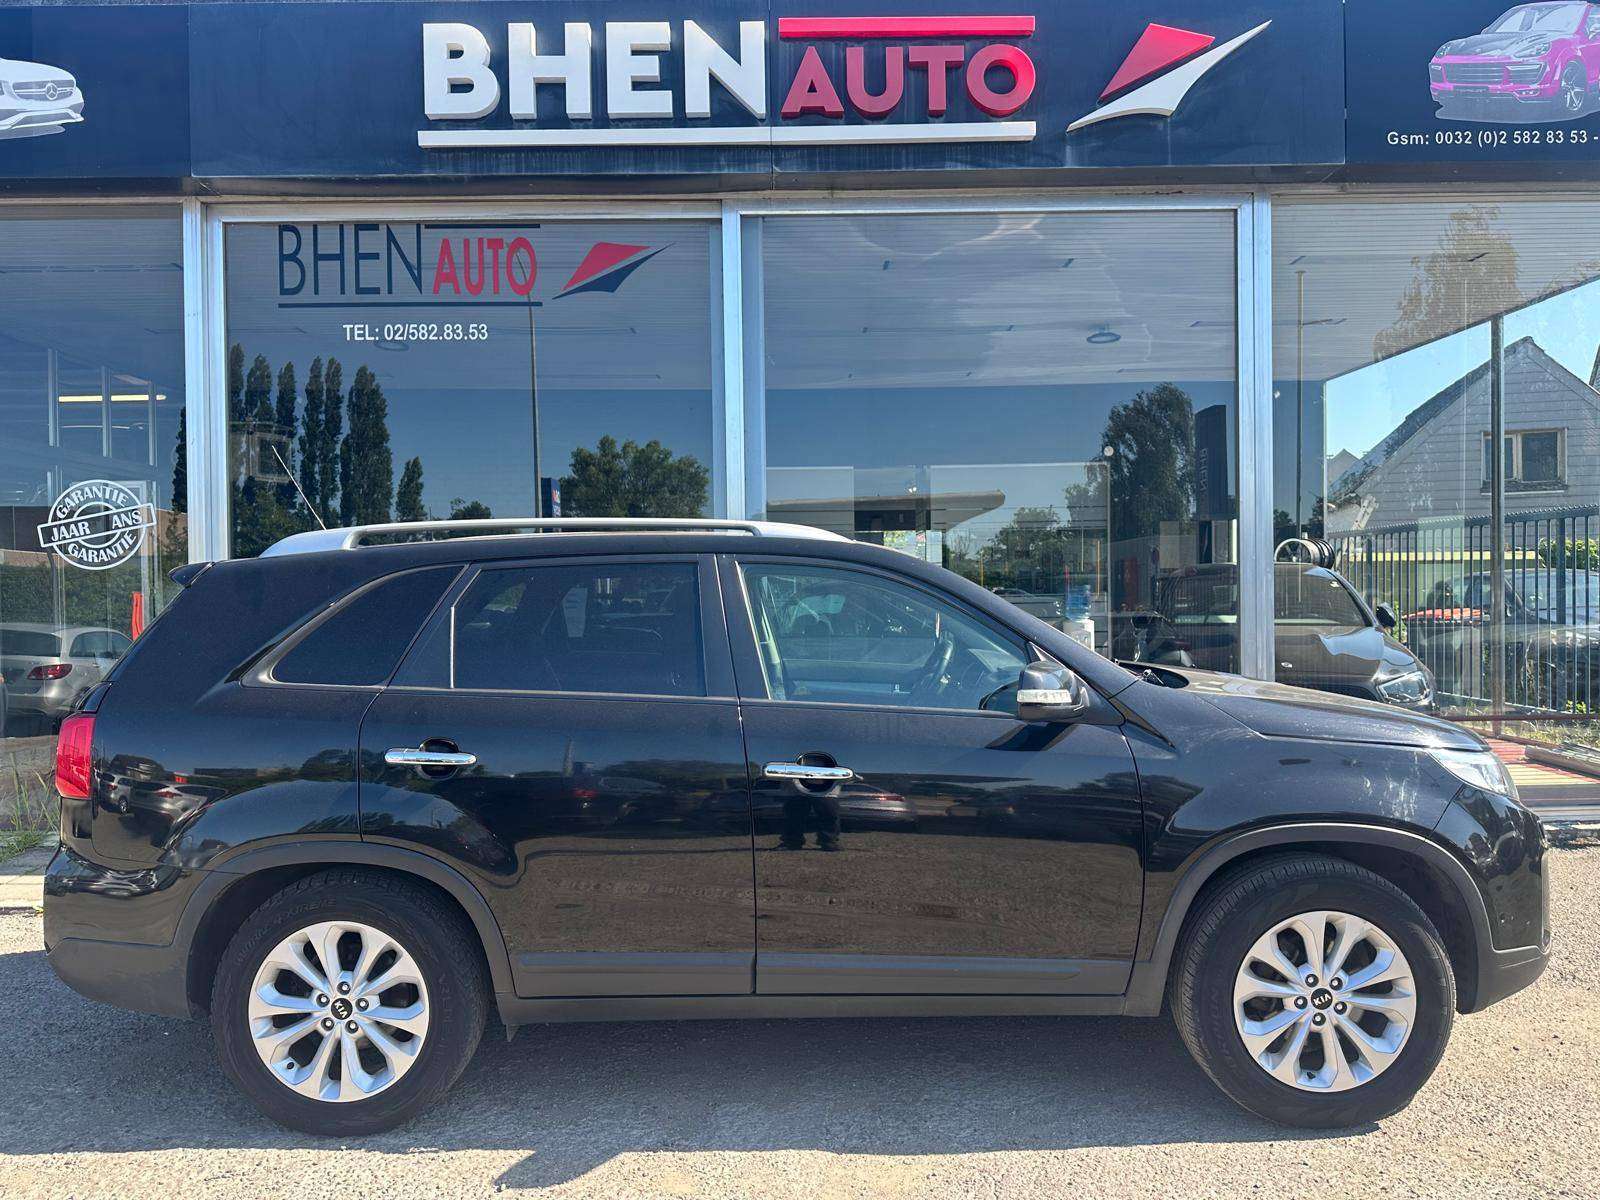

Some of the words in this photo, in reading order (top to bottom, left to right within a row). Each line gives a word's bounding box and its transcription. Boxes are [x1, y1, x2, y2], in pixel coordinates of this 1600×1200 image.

[422, 19, 767, 120] BHEN
[780, 44, 1037, 119] AUTO
[1387, 131, 1429, 145] Gsm:
[1435, 131, 1472, 144] 0032
[1478, 130, 1507, 148] (0)2
[1513, 130, 1540, 144] 582
[1546, 130, 1564, 144] 83
[1570, 130, 1588, 143] 53
[278, 223, 423, 295] BHEN
[433, 236, 538, 296] AUTO
[343, 324, 379, 341] TEL:
[384, 323, 488, 341] 02/582.83.53
[55, 486, 129, 519] GARANTIE
[51, 521, 91, 542] JAAR
[112, 510, 142, 530] ANS
[67, 530, 137, 563] GARANTIE
[334, 1000, 348, 1018] KIA
[1313, 993, 1332, 1006] KIA
